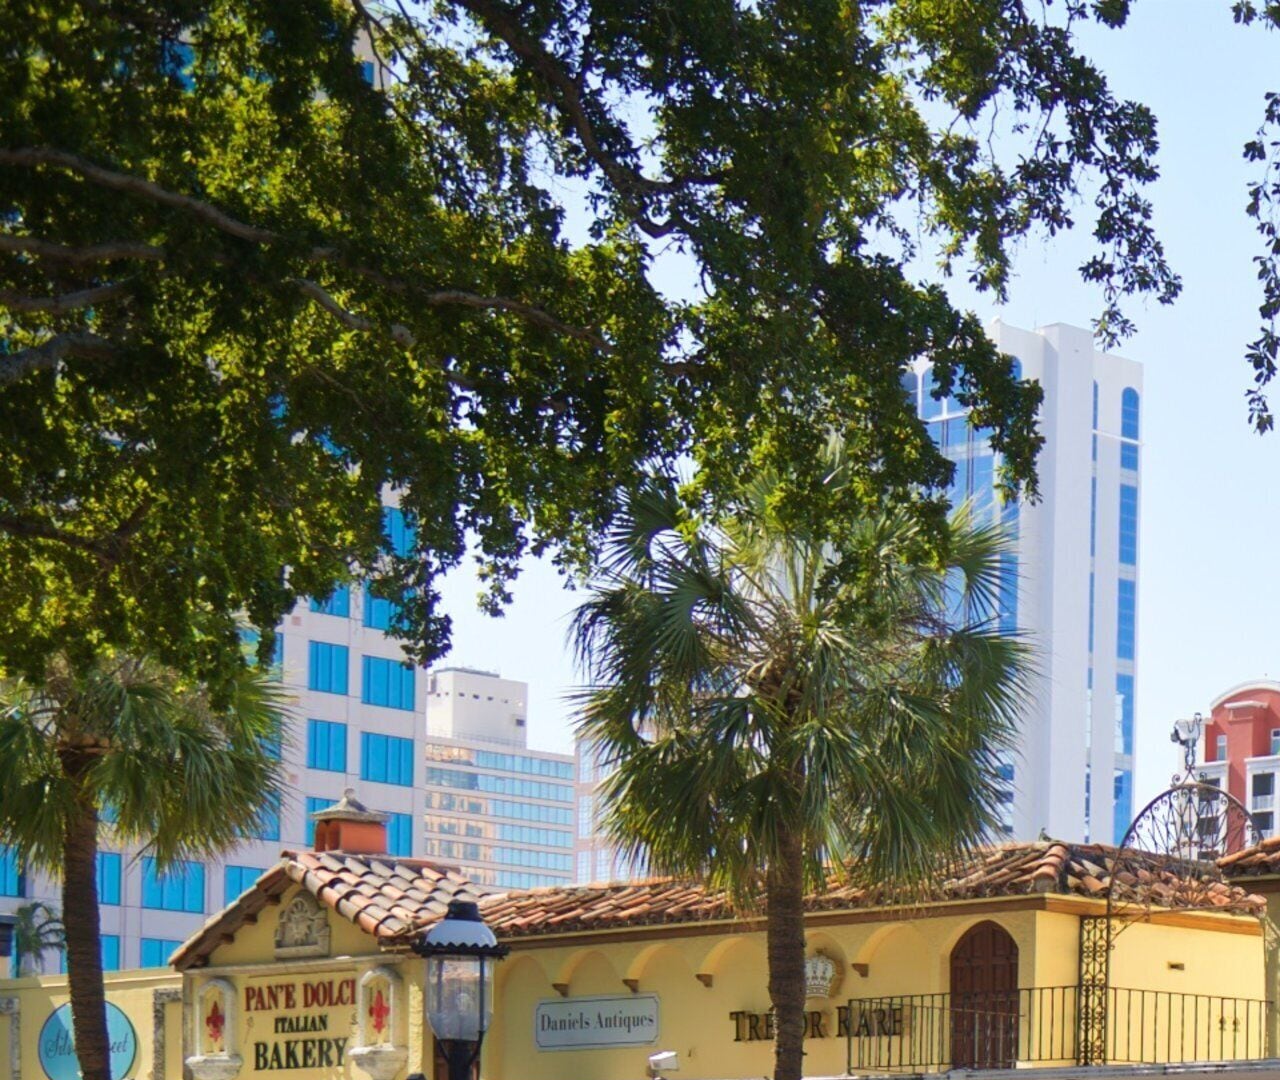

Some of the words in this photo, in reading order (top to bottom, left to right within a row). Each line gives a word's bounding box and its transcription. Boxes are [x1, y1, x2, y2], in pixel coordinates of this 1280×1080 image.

[303, 978, 357, 1008] DOLCI
[274, 1014, 328, 1033] ITALIAN
[541, 1012, 591, 1032] Daniels
[594, 1010, 654, 1033] Antiques
[836, 1005, 904, 1038] RARE
[253, 1036, 348, 1071] BAKERY
